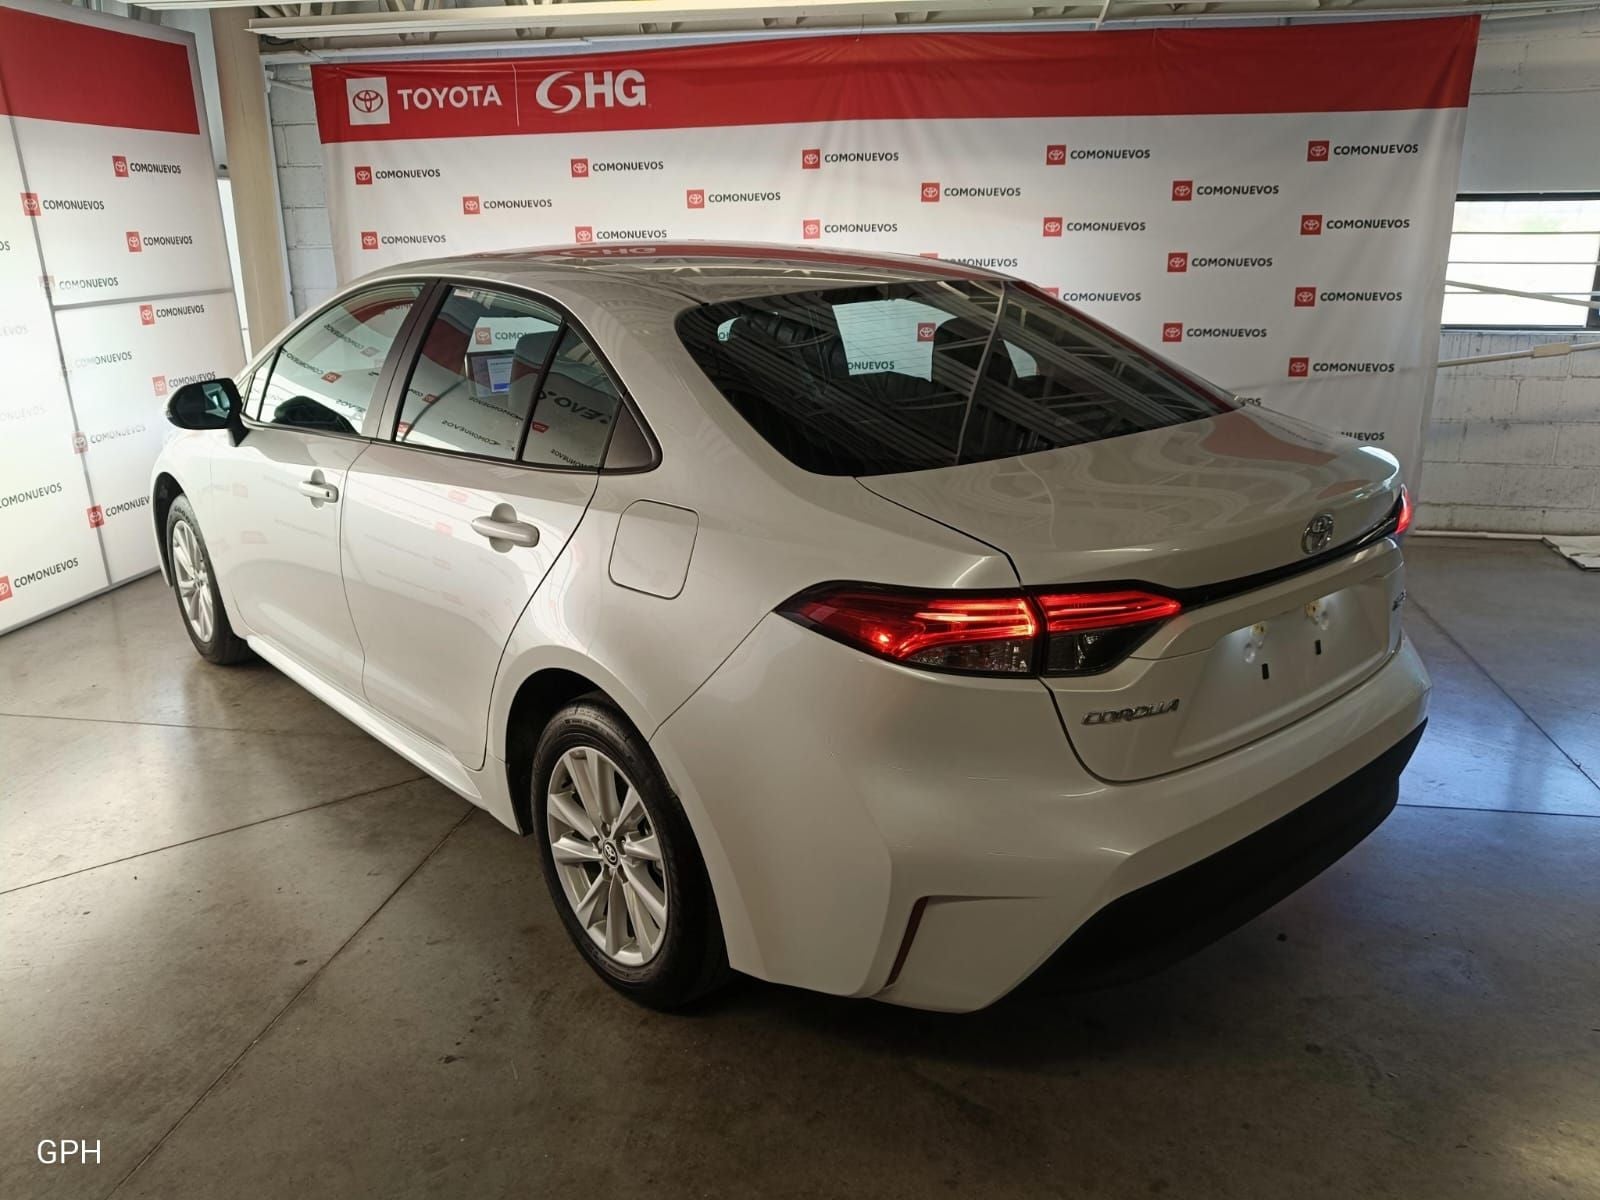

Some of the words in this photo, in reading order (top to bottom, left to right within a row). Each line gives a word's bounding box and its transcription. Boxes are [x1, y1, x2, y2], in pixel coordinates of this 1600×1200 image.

[398, 85, 502, 109] TOYOTA
[1070, 148, 1151, 160] COMONUEVOS
[1333, 143, 1419, 156] COMONUEVOS
[824, 151, 899, 163] COMONUEVOS
[129, 162, 182, 175] COMONUEVOS
[592, 160, 664, 172] COMONUEVOS
[375, 168, 441, 180] COMONUEVOS
[943, 187, 1021, 197] COMONUEVOS
[1196, 184, 1280, 196] COMONUEVOS
[708, 191, 781, 203] COMONUEVOS
[42, 199, 105, 211] COMONUEVOS
[483, 198, 553, 210] COMONUEVOS
[824, 223, 898, 234] COMONUEVOS
[1066, 221, 1147, 232] COMONUEVOS
[1326, 218, 1410, 230] COMONUEVOS
[380, 234, 447, 245] COMONUEVOS
[596, 228, 667, 239] COMONUEVOS
[143, 235, 193, 247] COMONUEVOS
[1191, 257, 1273, 268] COMONUEVOS
[59, 276, 119, 290] COMONUEVOS
[1063, 292, 1142, 301] COMONUEVOS
[1319, 291, 1403, 302] COMONUEVOS
[155, 303, 205, 319] COMONUEVOS
[1186, 328, 1268, 338] COMONUEVOS
[1312, 362, 1395, 373] COMONUEVOS
[89, 424, 147, 446] COMONUEVOS
[0, 482, 63, 509] OMONUEVOS
[13, 557, 79, 589] COMONUEVOS
[1081, 698, 1180, 725] COROLLA
